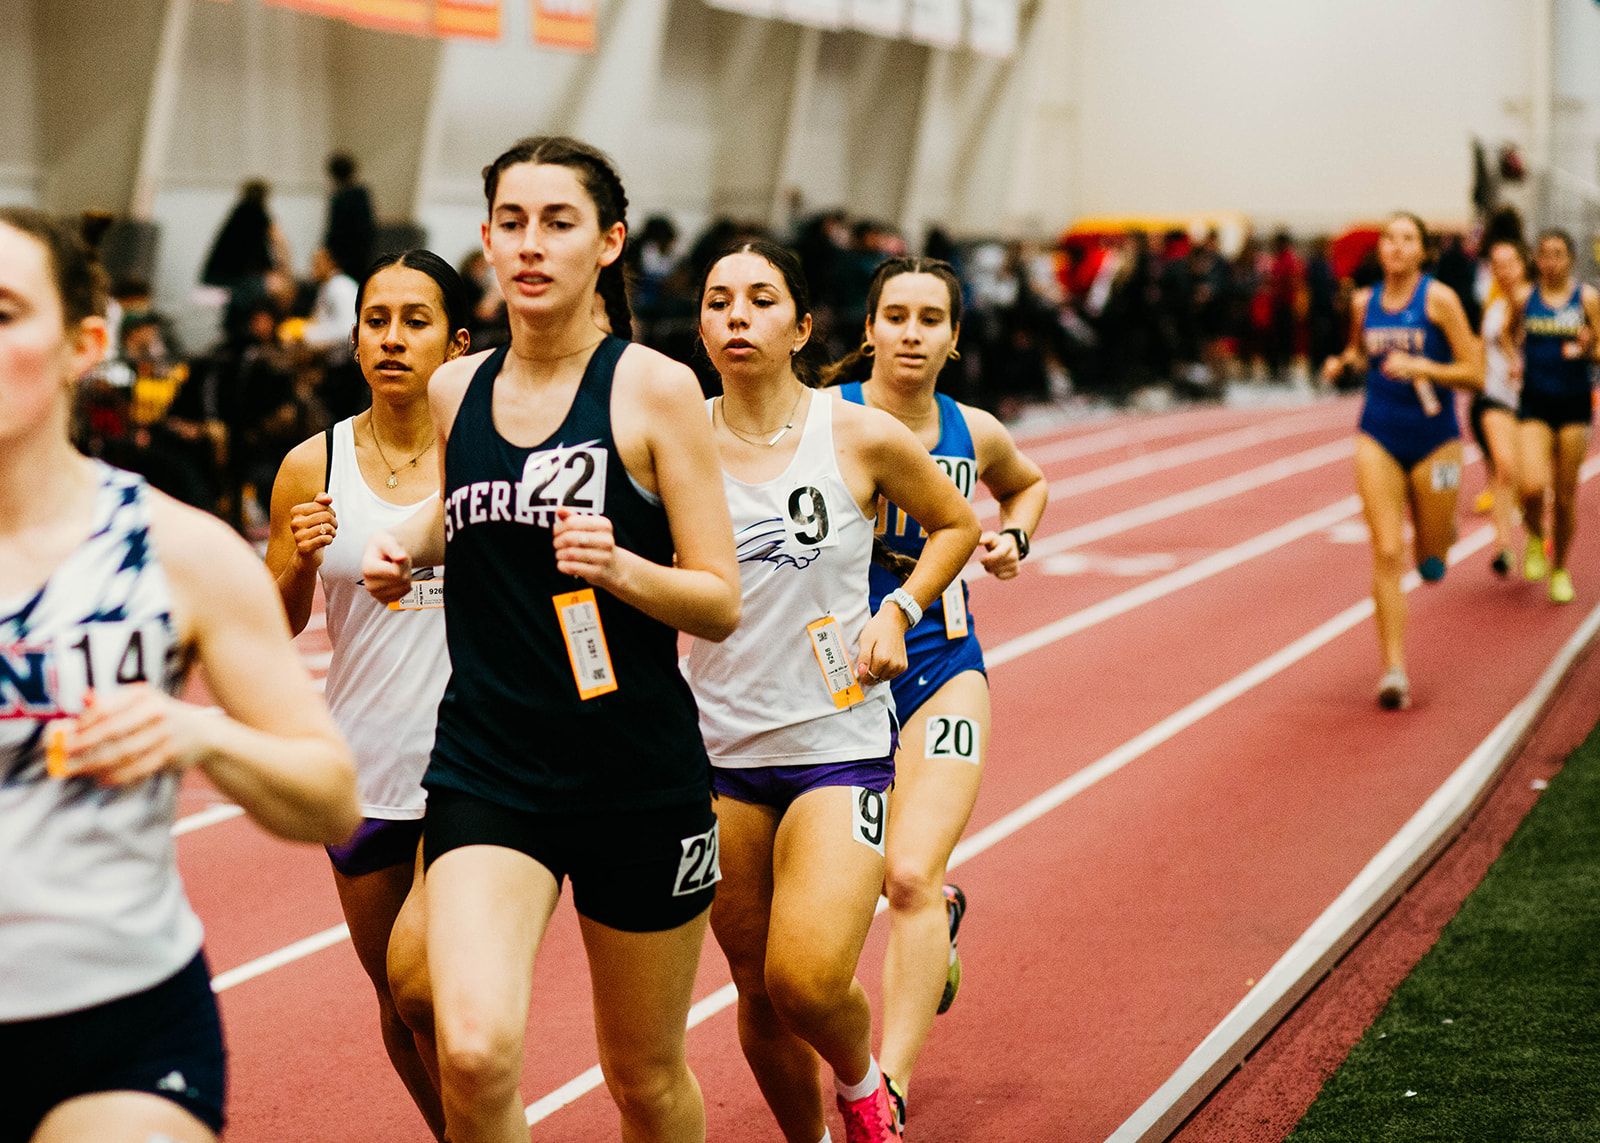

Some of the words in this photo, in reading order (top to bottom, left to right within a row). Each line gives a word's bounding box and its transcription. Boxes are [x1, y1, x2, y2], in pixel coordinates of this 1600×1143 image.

[529, 452, 594, 508] 22
[445, 480, 566, 542] STERL
[788, 486, 829, 545] 9
[70, 630, 147, 687] 14
[930, 718, 973, 757] 20
[859, 788, 884, 846] 9
[679, 830, 716, 892] 22
